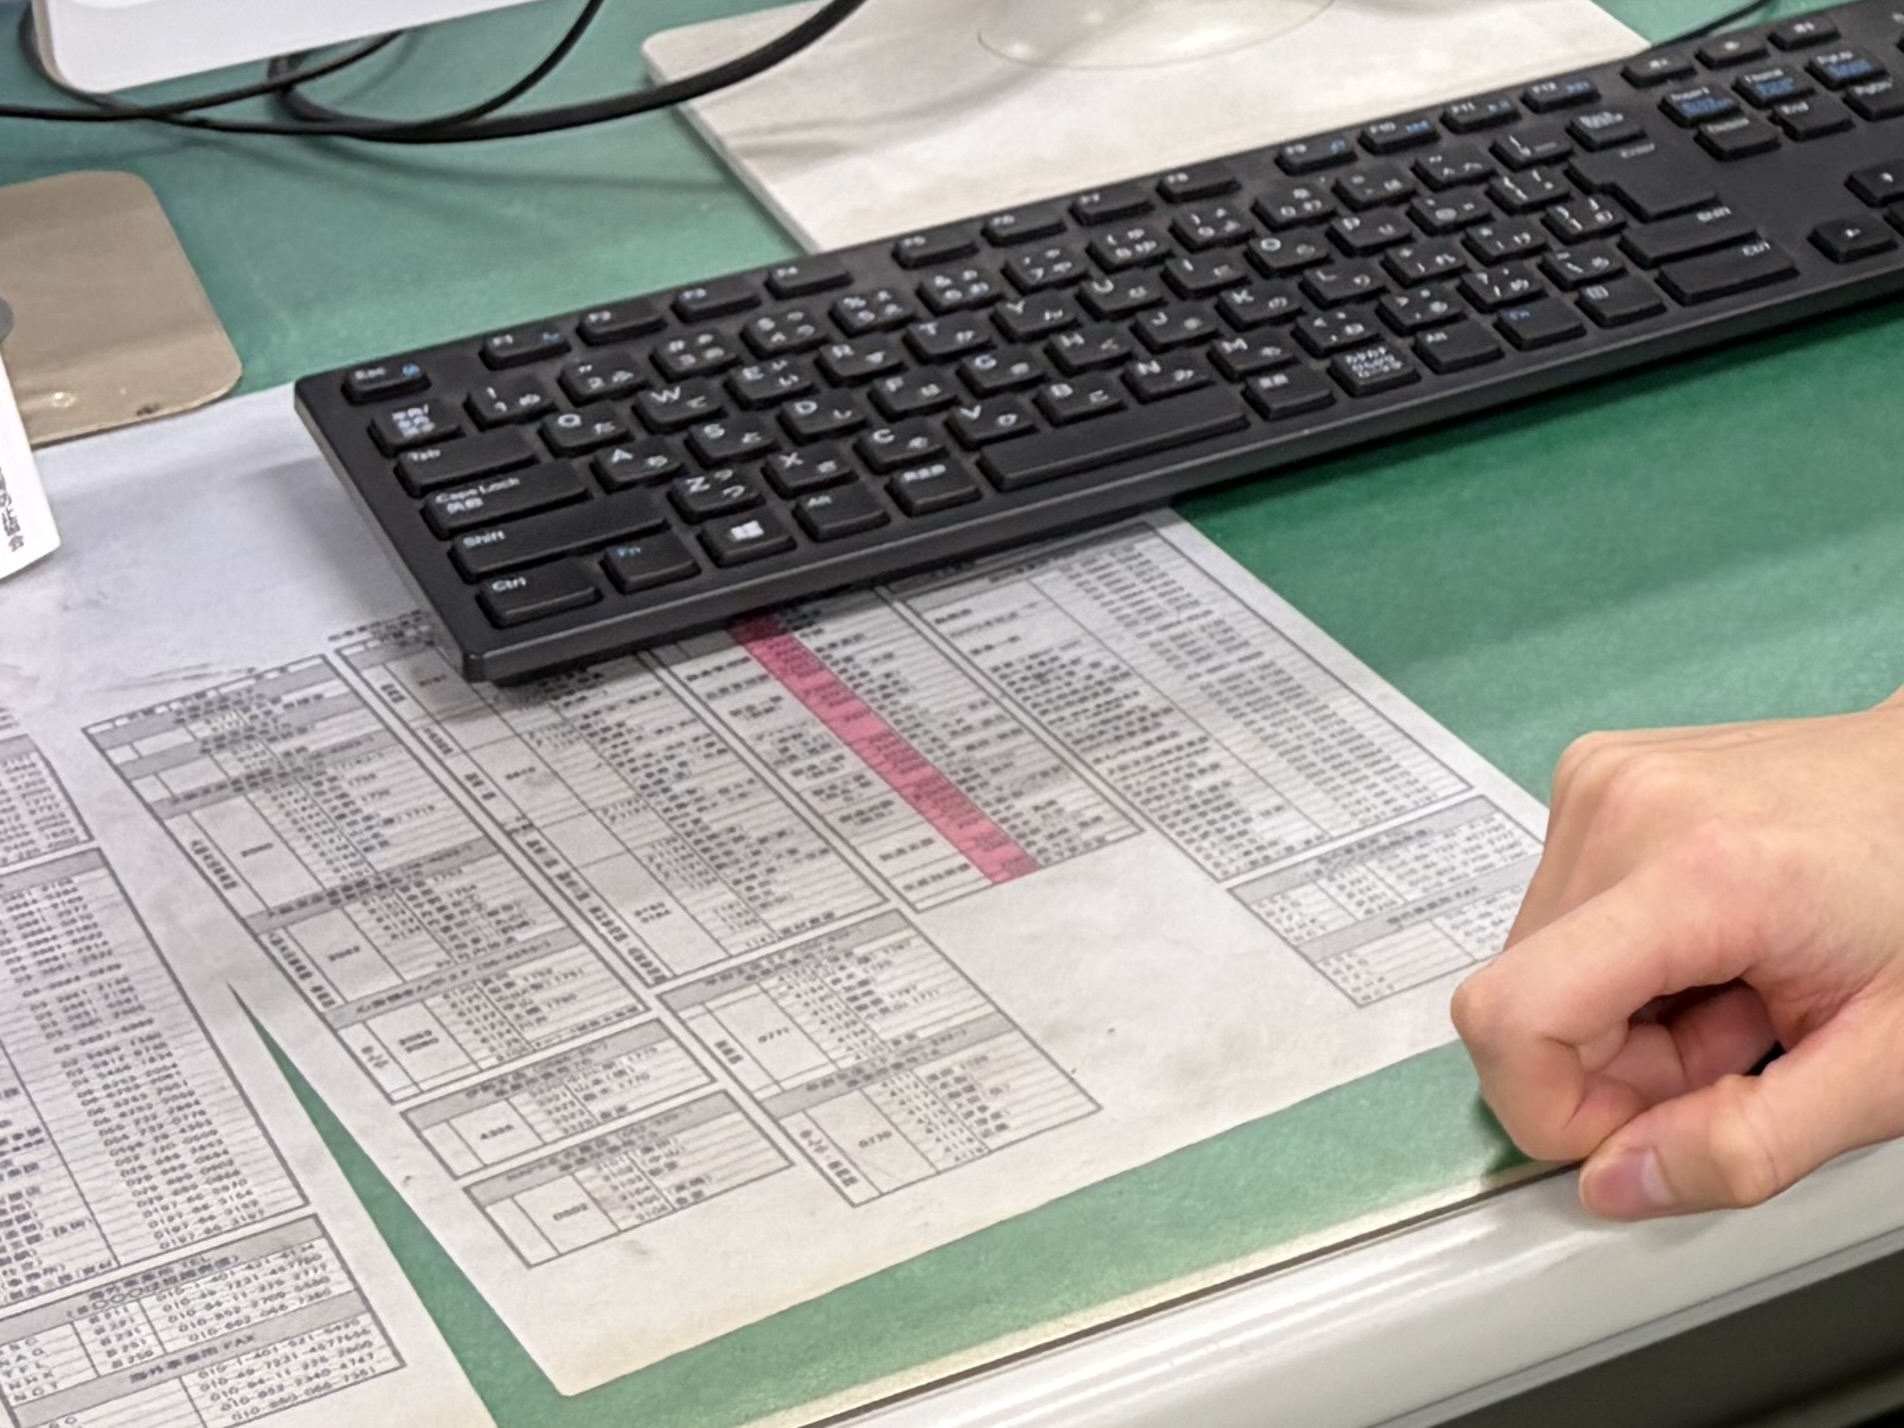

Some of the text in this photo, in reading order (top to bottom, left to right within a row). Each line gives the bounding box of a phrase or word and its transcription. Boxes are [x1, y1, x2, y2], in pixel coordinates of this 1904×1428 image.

[1260, 237, 1282, 251] O
[1316, 270, 1337, 282] L
[1091, 279, 1115, 293] U
[1231, 289, 1254, 304] K
[1006, 300, 1026, 314] Y
[1151, 311, 1168, 326] J
[919, 321, 938, 336] T
[1060, 332, 1085, 347] H
[1221, 338, 1248, 353] M
[742, 365, 764, 380] E
[1136, 360, 1161, 375] N
[650, 386, 681, 403] W
[794, 400, 818, 415] D
[960, 404, 982, 420] V
[557, 413, 582, 428] Q
[703, 423, 725, 439] S
[872, 429, 895, 444] C
[611, 449, 634, 463] A
[779, 452, 803, 468] X
[685, 476, 711, 493] Z
[463, 530, 506, 548] Shift
[492, 576, 527, 592] Ctrl
